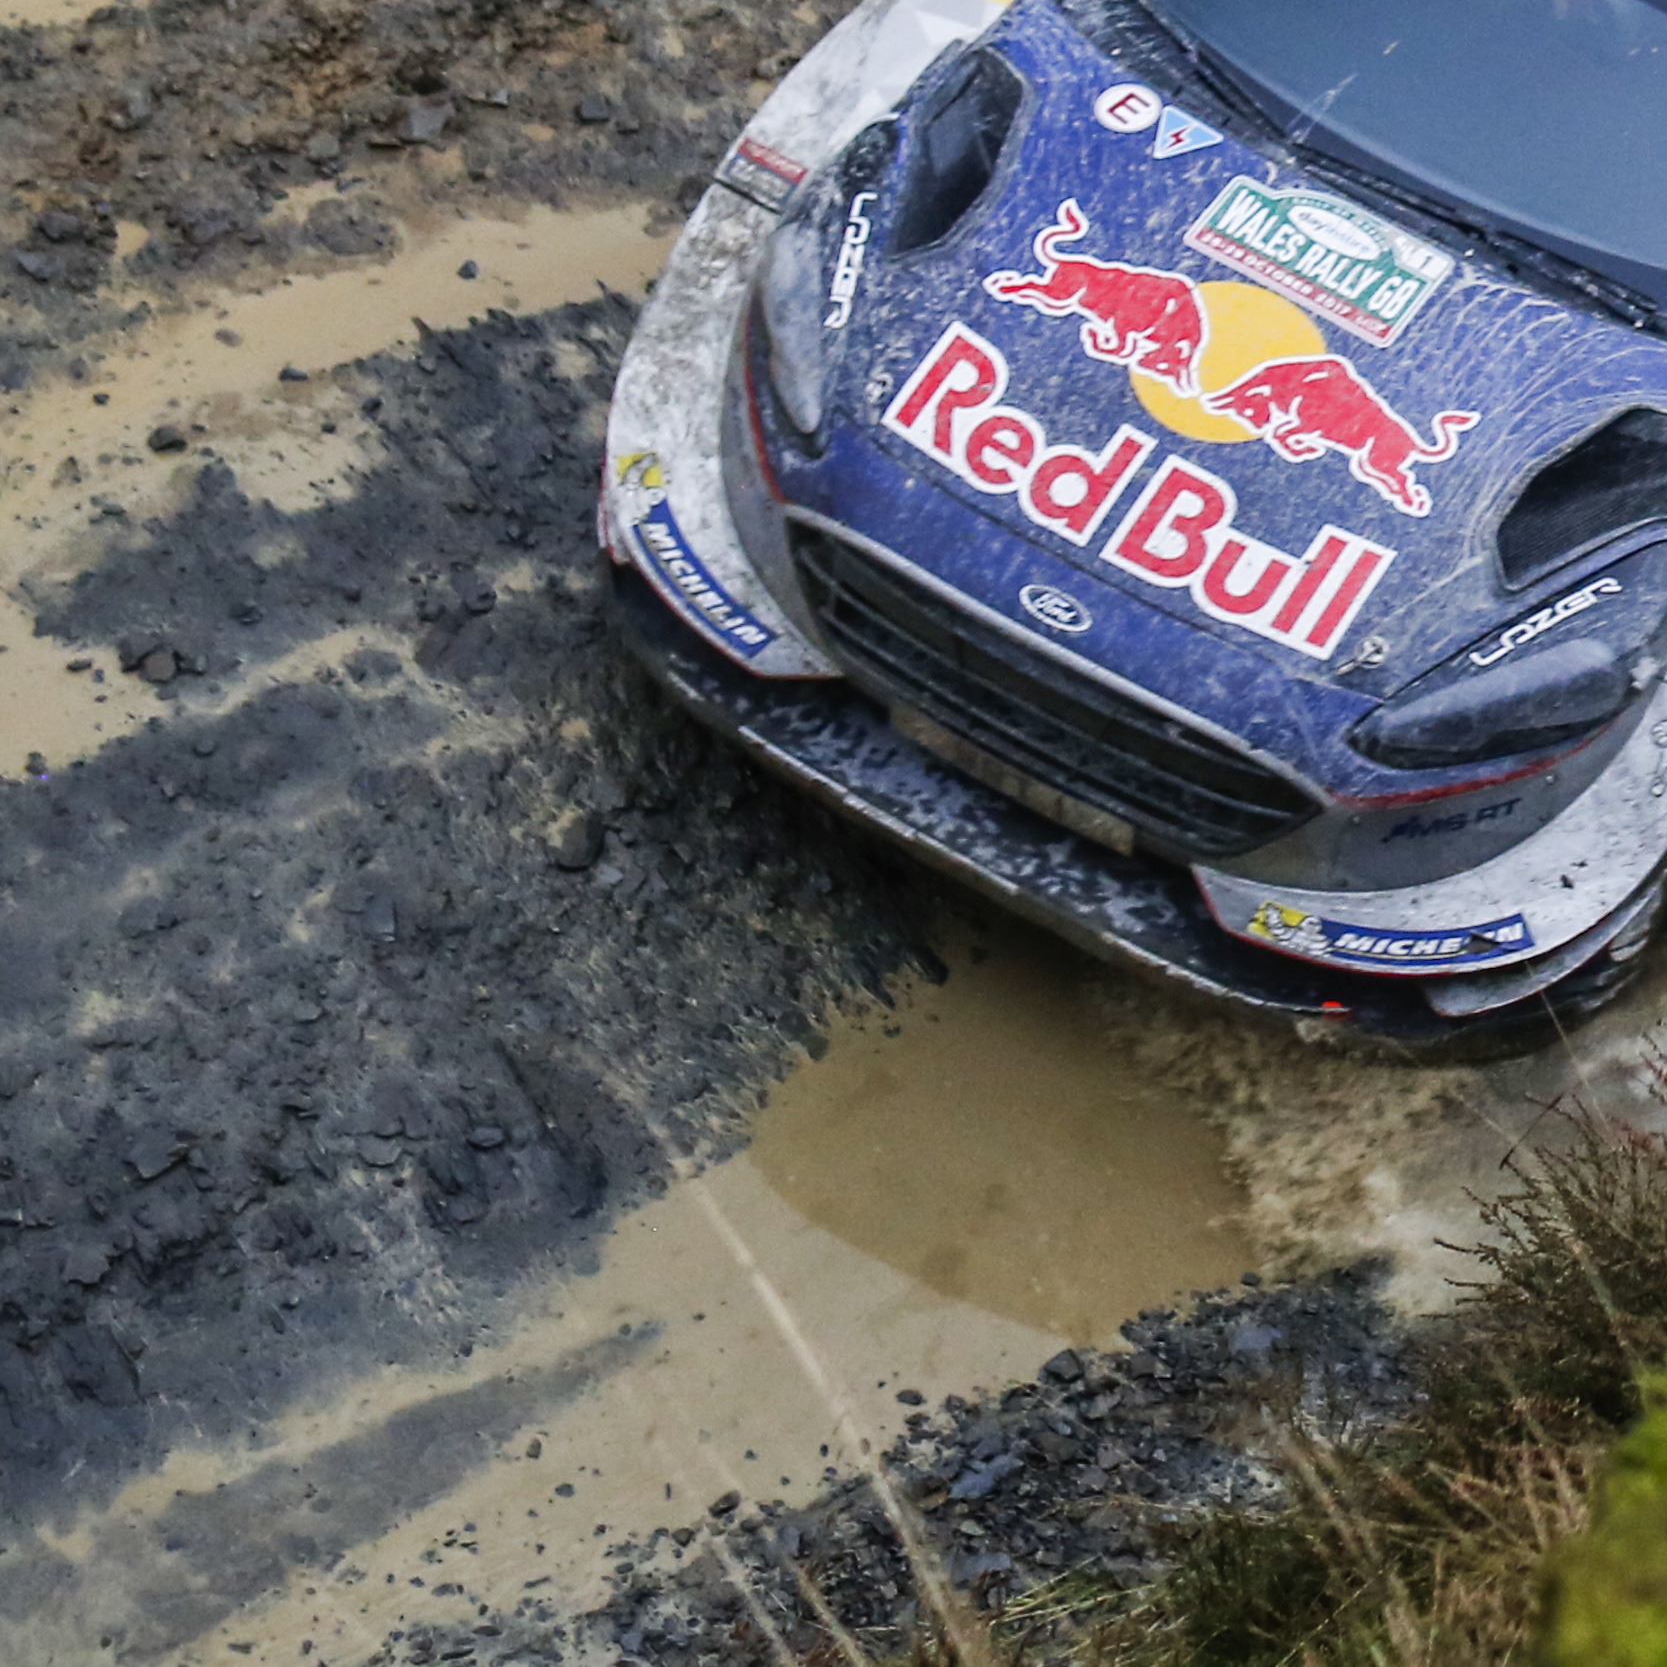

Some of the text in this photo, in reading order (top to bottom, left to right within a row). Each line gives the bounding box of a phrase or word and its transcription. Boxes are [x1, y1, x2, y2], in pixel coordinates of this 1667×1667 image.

[1107, 92, 1151, 125] E
[1215, 187, 1307, 263] WALES
[1293, 242, 1385, 300] RALLY
[1367, 275, 1420, 320] GB
[1242, 254, 1315, 295] OCTOBER
[1313, 291, 1353, 316] 2017
[888, 327, 1390, 652] Red Bull
[645, 522, 768, 646] MICHELIN
[1032, 592, 1078, 624] Ford
